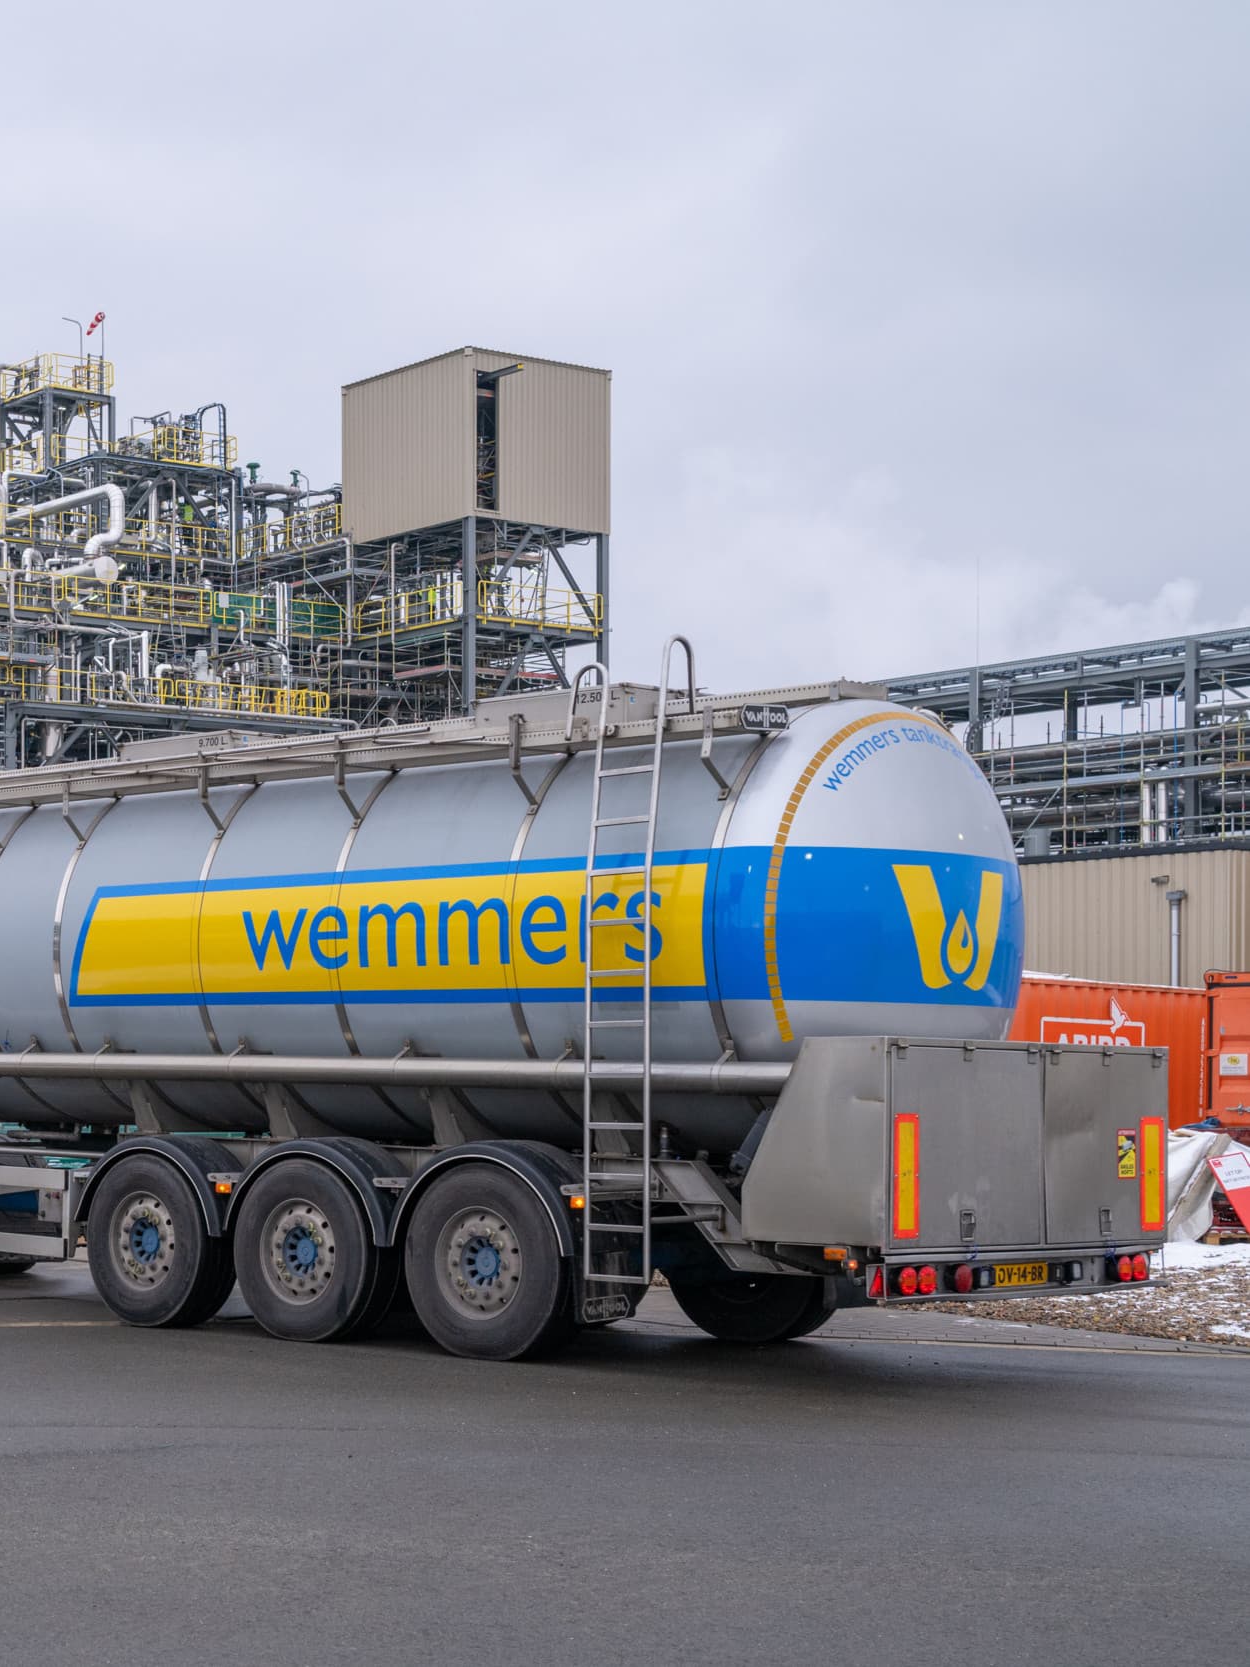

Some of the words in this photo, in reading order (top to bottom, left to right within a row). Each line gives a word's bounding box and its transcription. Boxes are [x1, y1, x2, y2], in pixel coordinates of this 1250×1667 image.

[575, 691, 602, 704] 12.50
[822, 728, 901, 792] wemmers
[242, 890, 663, 972] wemmers
